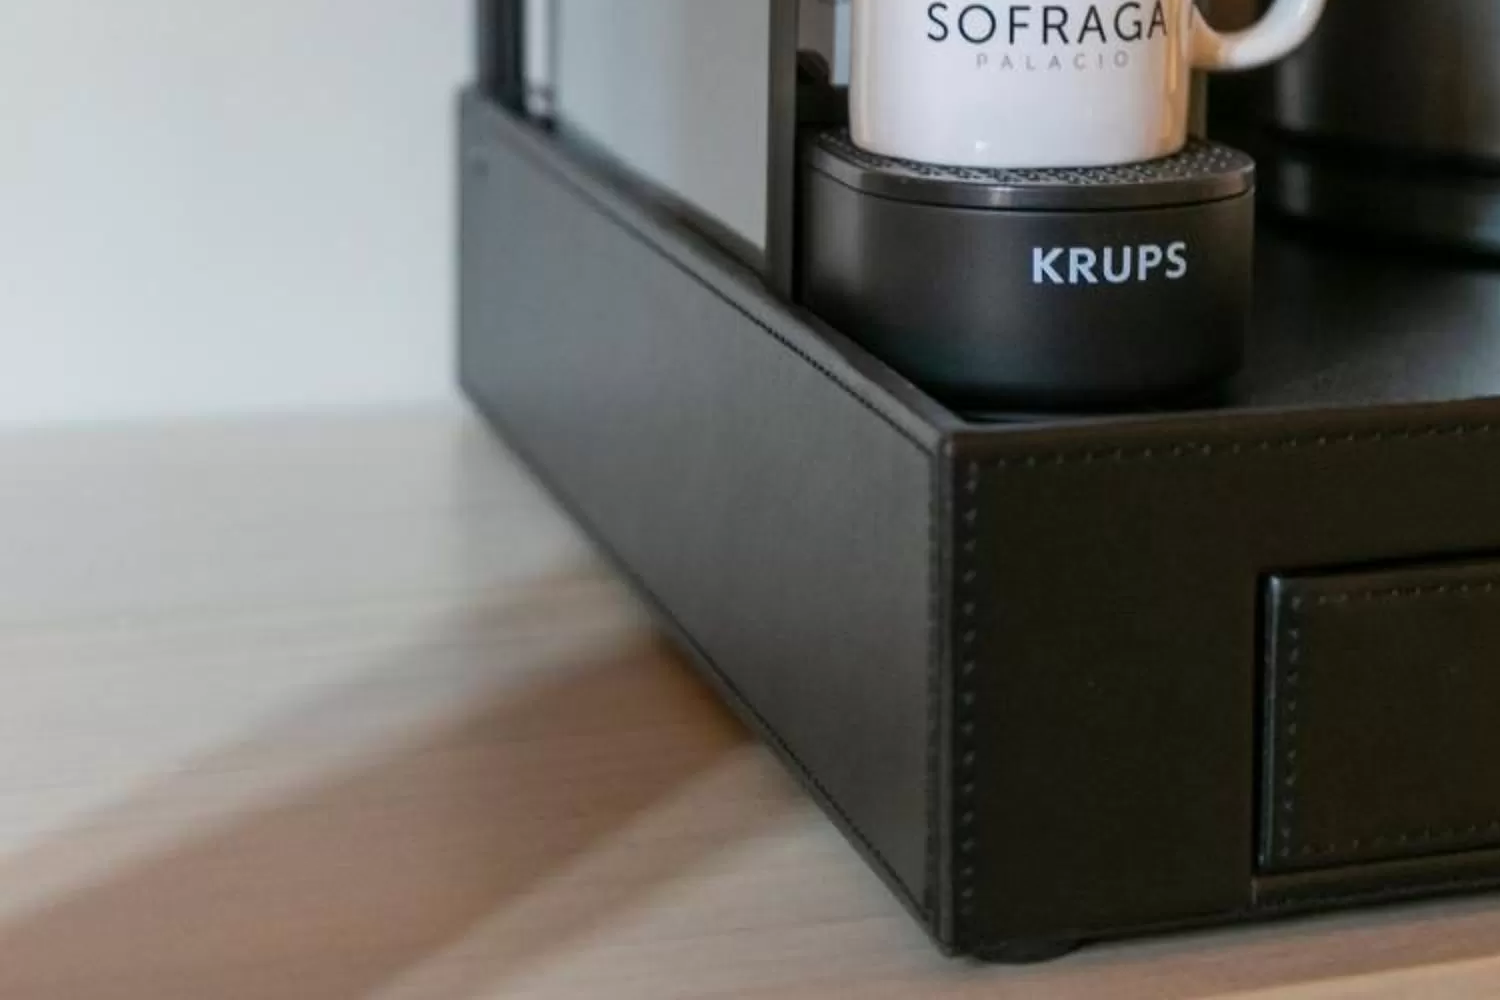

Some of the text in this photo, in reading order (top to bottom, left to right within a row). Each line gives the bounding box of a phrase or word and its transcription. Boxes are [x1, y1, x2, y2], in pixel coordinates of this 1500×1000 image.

[927, 0, 1168, 45] SOFRAGA
[975, 51, 1129, 70] PALACIO
[1031, 242, 1188, 285] KRUPS
